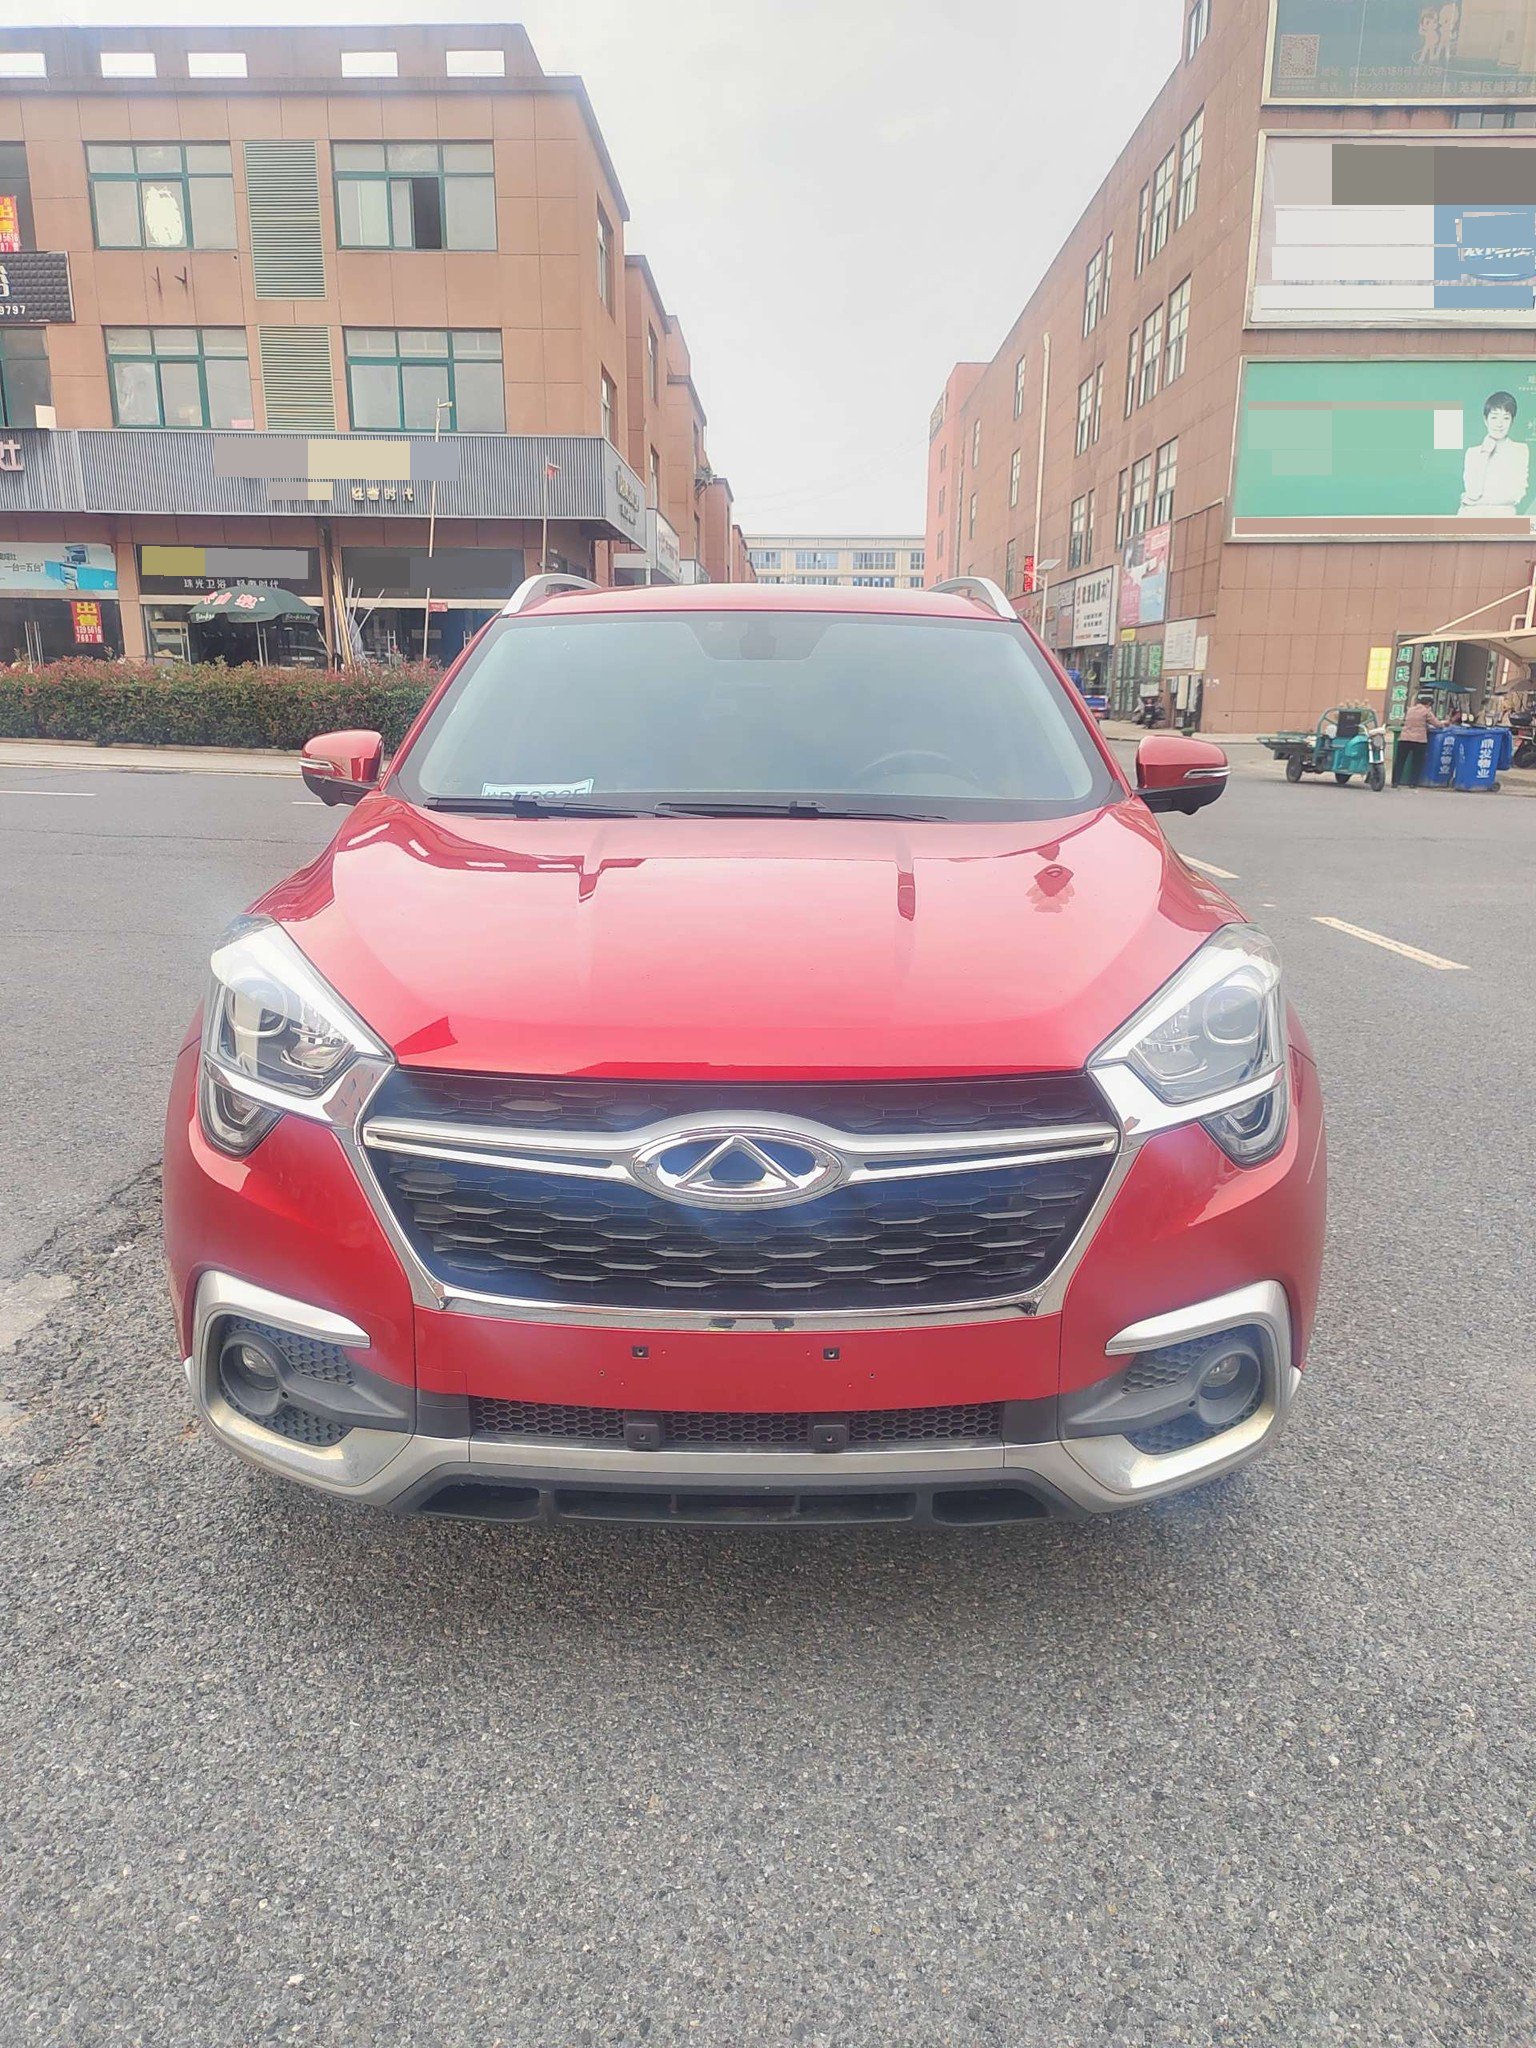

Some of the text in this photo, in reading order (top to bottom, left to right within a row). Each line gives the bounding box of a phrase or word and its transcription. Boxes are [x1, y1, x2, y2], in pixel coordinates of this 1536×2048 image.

[1389, 646, 1413, 721] 周氏家具
[1476, 739, 1494, 778] 鼎发物业
